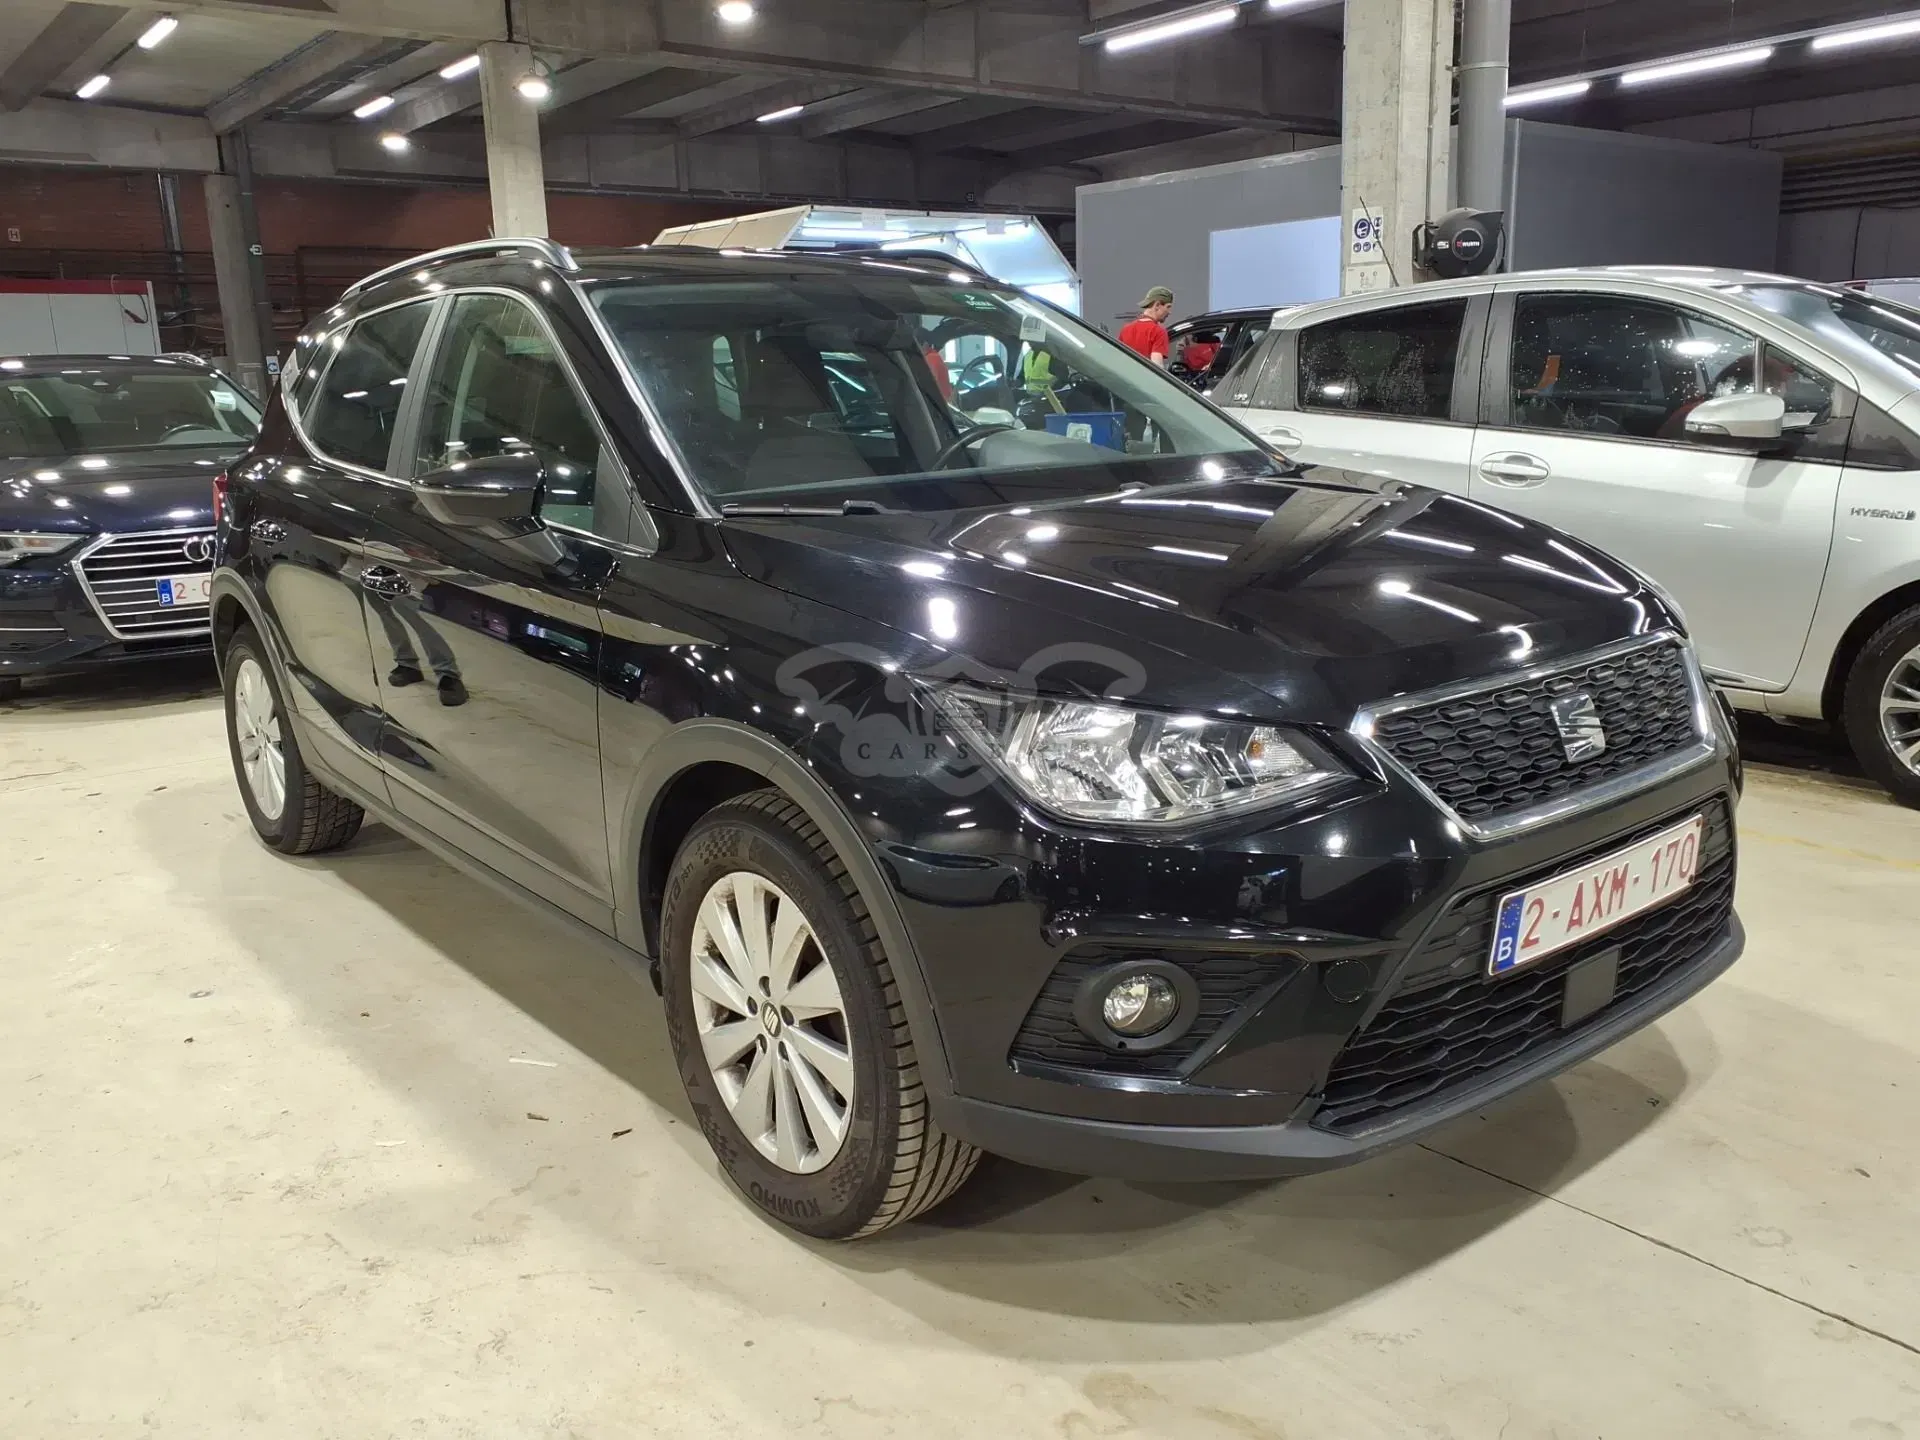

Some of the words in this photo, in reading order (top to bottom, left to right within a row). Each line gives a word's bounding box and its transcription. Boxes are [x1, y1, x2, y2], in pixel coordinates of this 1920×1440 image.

[1850, 507, 1905, 520] HYBRID
[161, 593, 171, 603] B
[1520, 832, 1695, 950] 2-AXM-170
[1497, 936, 1514, 962] B
[750, 1181, 822, 1219] KUMHO
